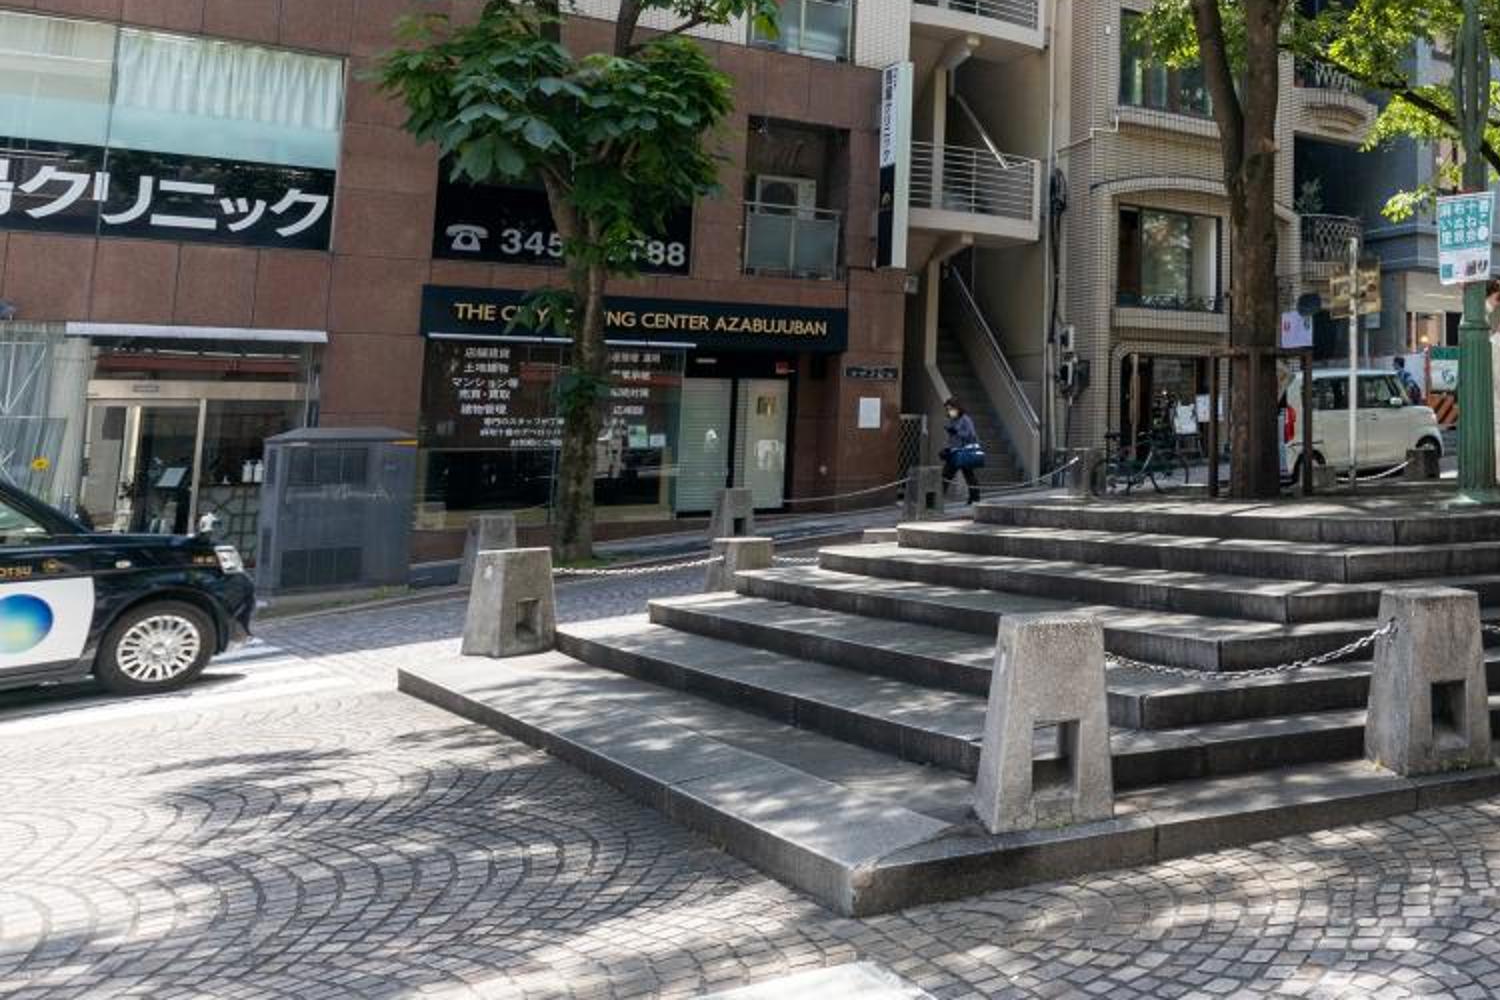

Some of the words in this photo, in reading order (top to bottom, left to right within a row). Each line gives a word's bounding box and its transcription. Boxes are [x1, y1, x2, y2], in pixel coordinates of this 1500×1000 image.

[0, 160, 330, 238] クリニック
[454, 303, 497, 321] THE
[641, 312, 709, 331] CENTER
[714, 317, 828, 337] AZABUJUBAN
